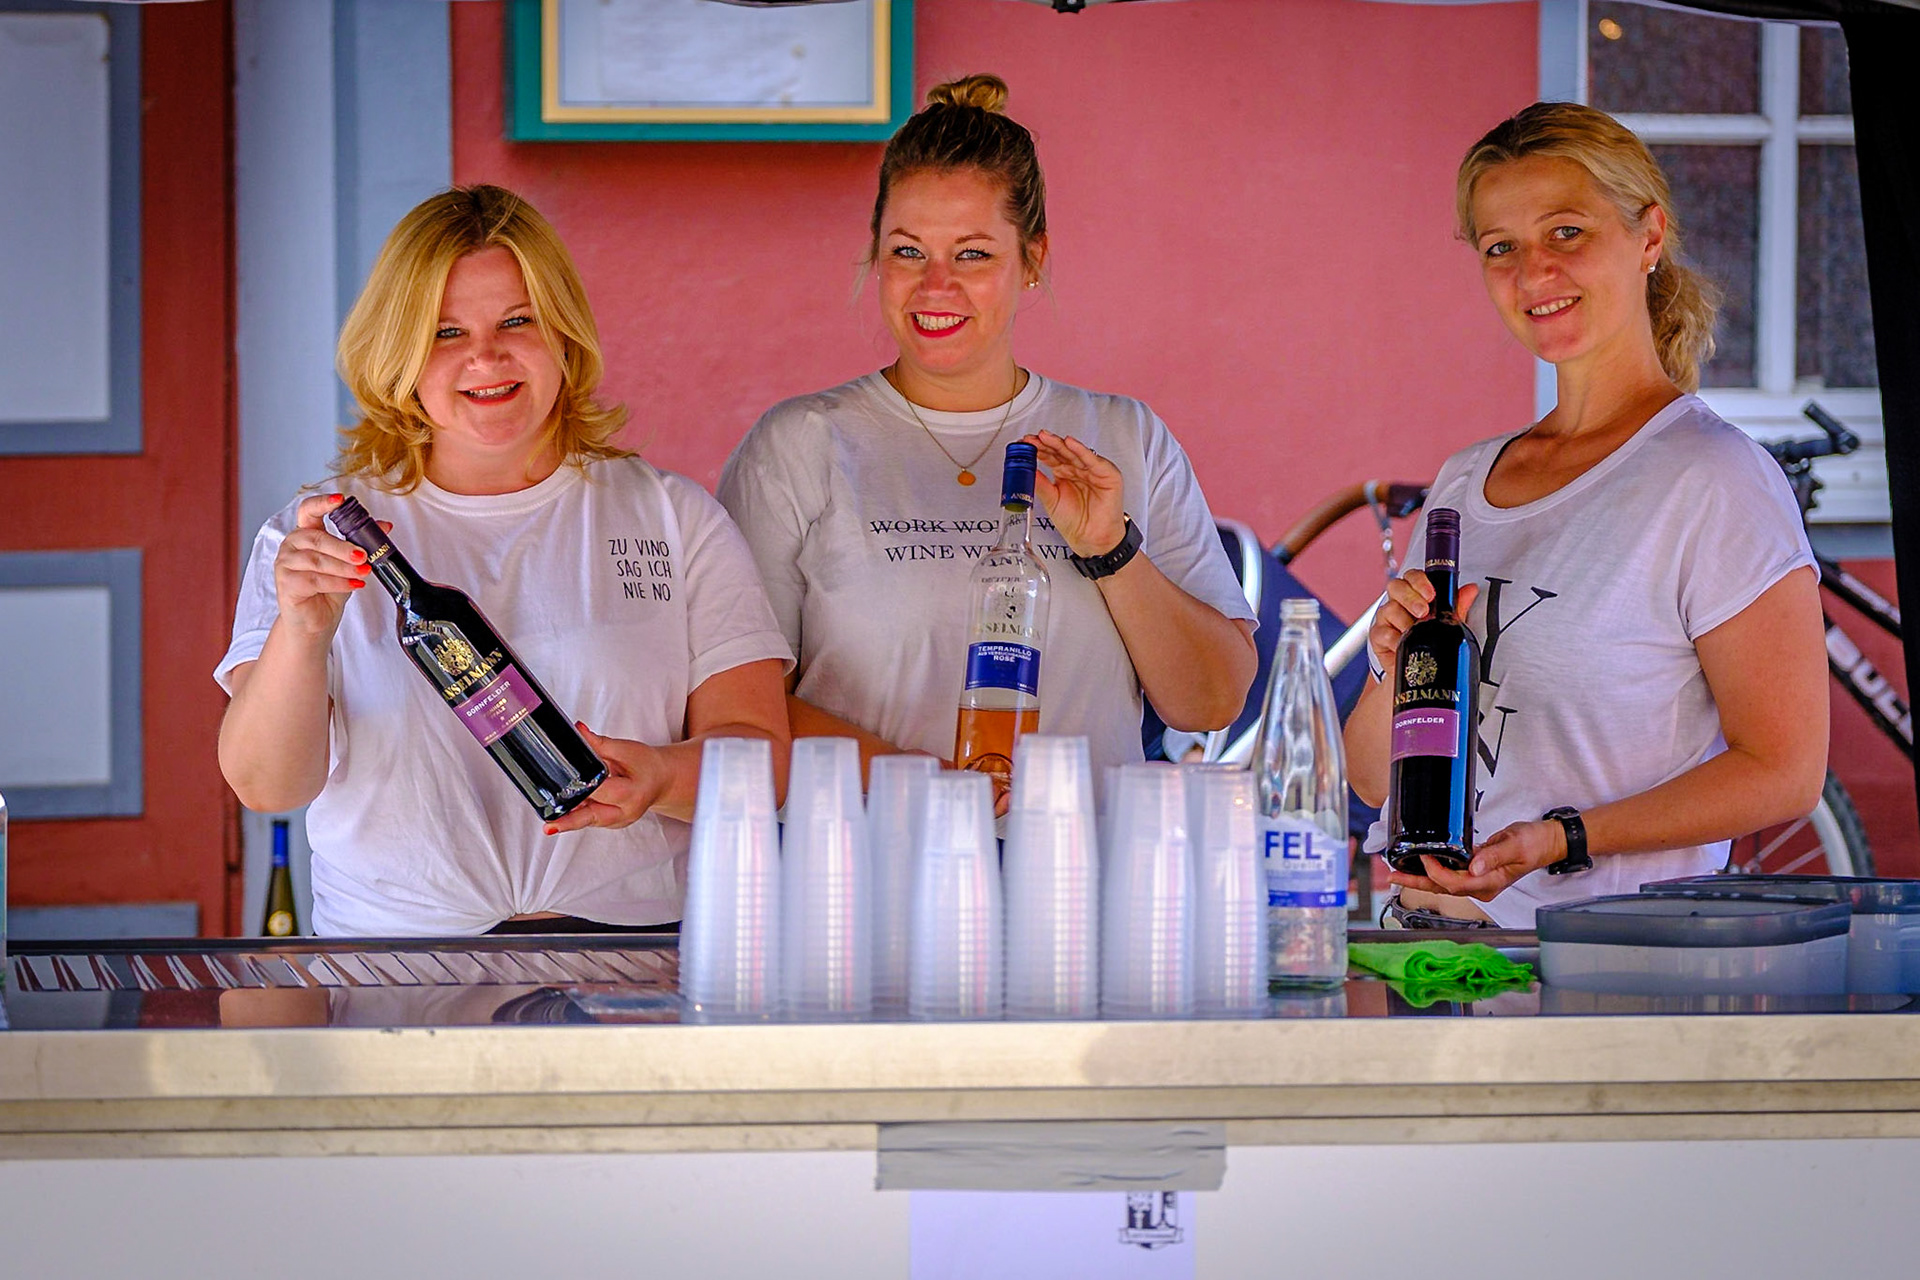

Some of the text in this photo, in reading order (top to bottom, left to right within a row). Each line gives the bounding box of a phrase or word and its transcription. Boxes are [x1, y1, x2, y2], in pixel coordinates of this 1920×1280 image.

[870, 518, 947, 534] WORK
[608, 538, 669, 557] ZU VINO
[884, 544, 955, 562] WINE
[616, 559, 672, 578] SAG ICH
[623, 581, 671, 602] NIE NO
[977, 645, 1032, 657] TEMPRANILLO
[465, 680, 512, 718] DORNFELDER
[1394, 717, 1445, 729] DORNFELDER
